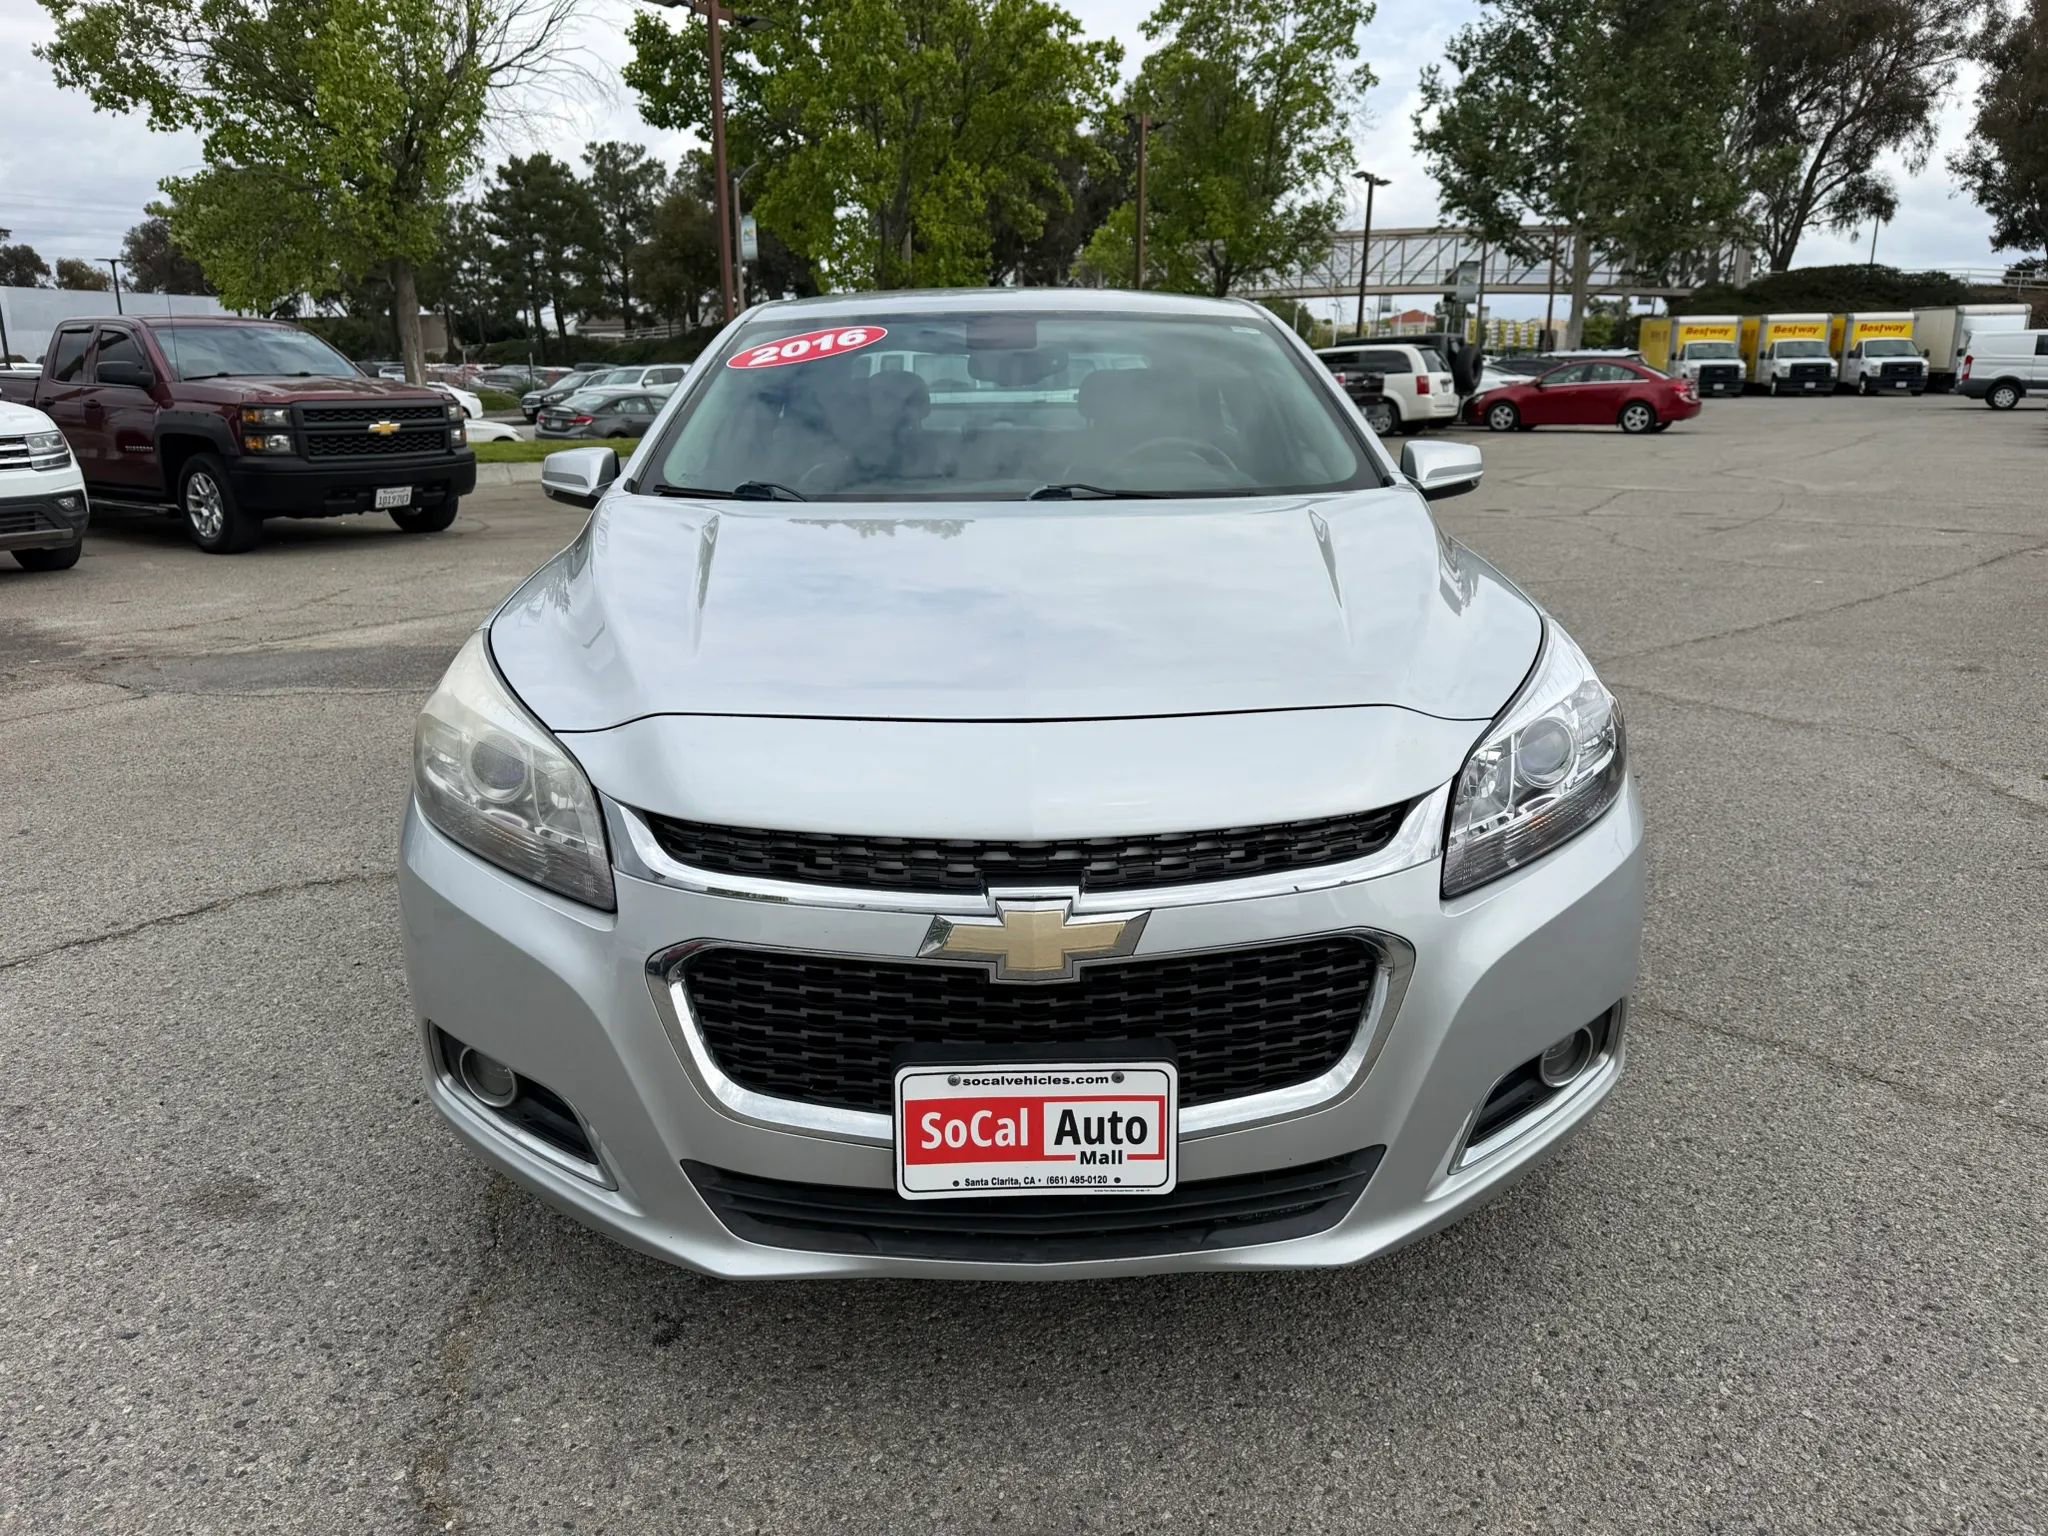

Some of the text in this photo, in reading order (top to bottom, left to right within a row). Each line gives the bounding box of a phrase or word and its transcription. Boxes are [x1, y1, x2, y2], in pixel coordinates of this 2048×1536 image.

[1685, 326, 1730, 337] Bestway
[1773, 325, 1820, 335] Bestway
[1860, 323, 1906, 333] Bestway
[748, 329, 868, 366] 2016
[962, 1075, 1109, 1087] socalvehicles.com
[921, 1107, 1148, 1150] SoCal Auto
[1080, 1150, 1123, 1165] Mall
[964, 1175, 1108, 1188] Santa Clarita, CA (661) 495-0120
